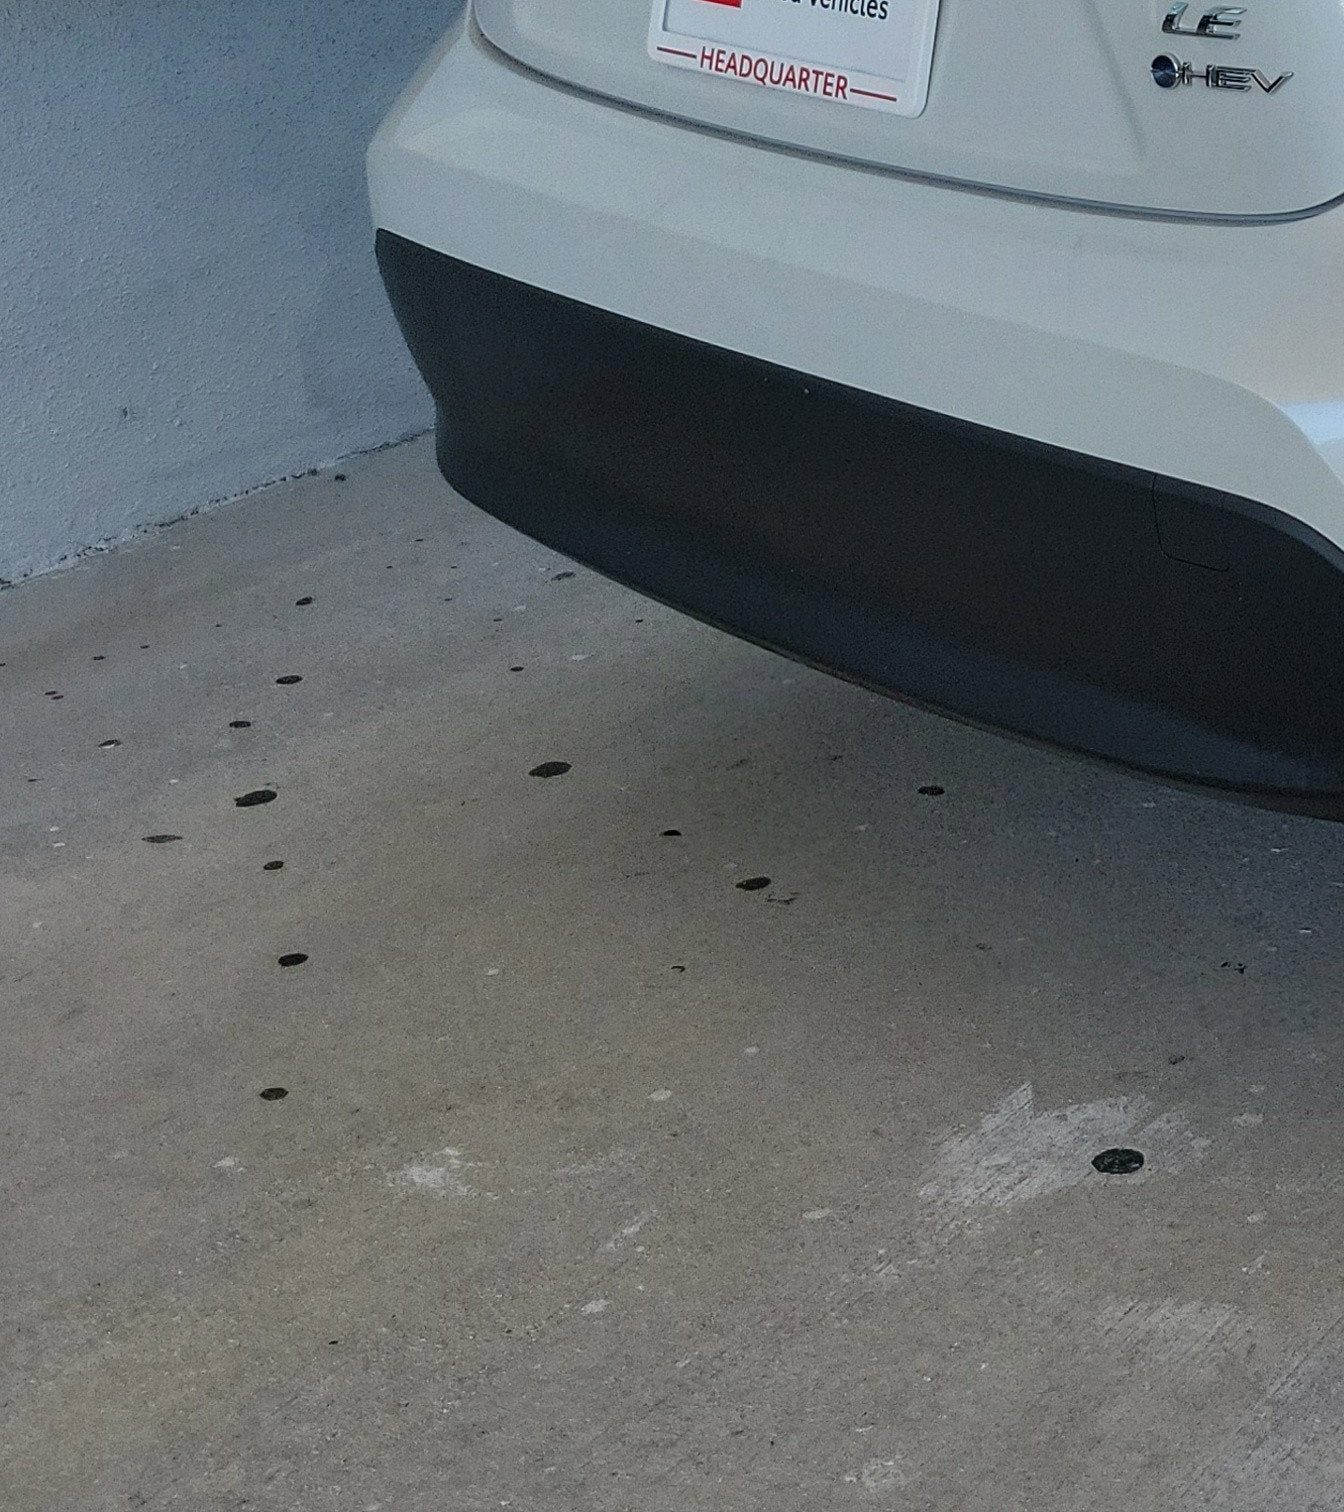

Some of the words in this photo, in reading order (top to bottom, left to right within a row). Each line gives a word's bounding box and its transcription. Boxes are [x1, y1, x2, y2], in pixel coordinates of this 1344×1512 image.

[1162, 2, 1247, 40] LE
[700, 46, 849, 100] HEADQUARTER
[1183, 61, 1294, 94] HEV
